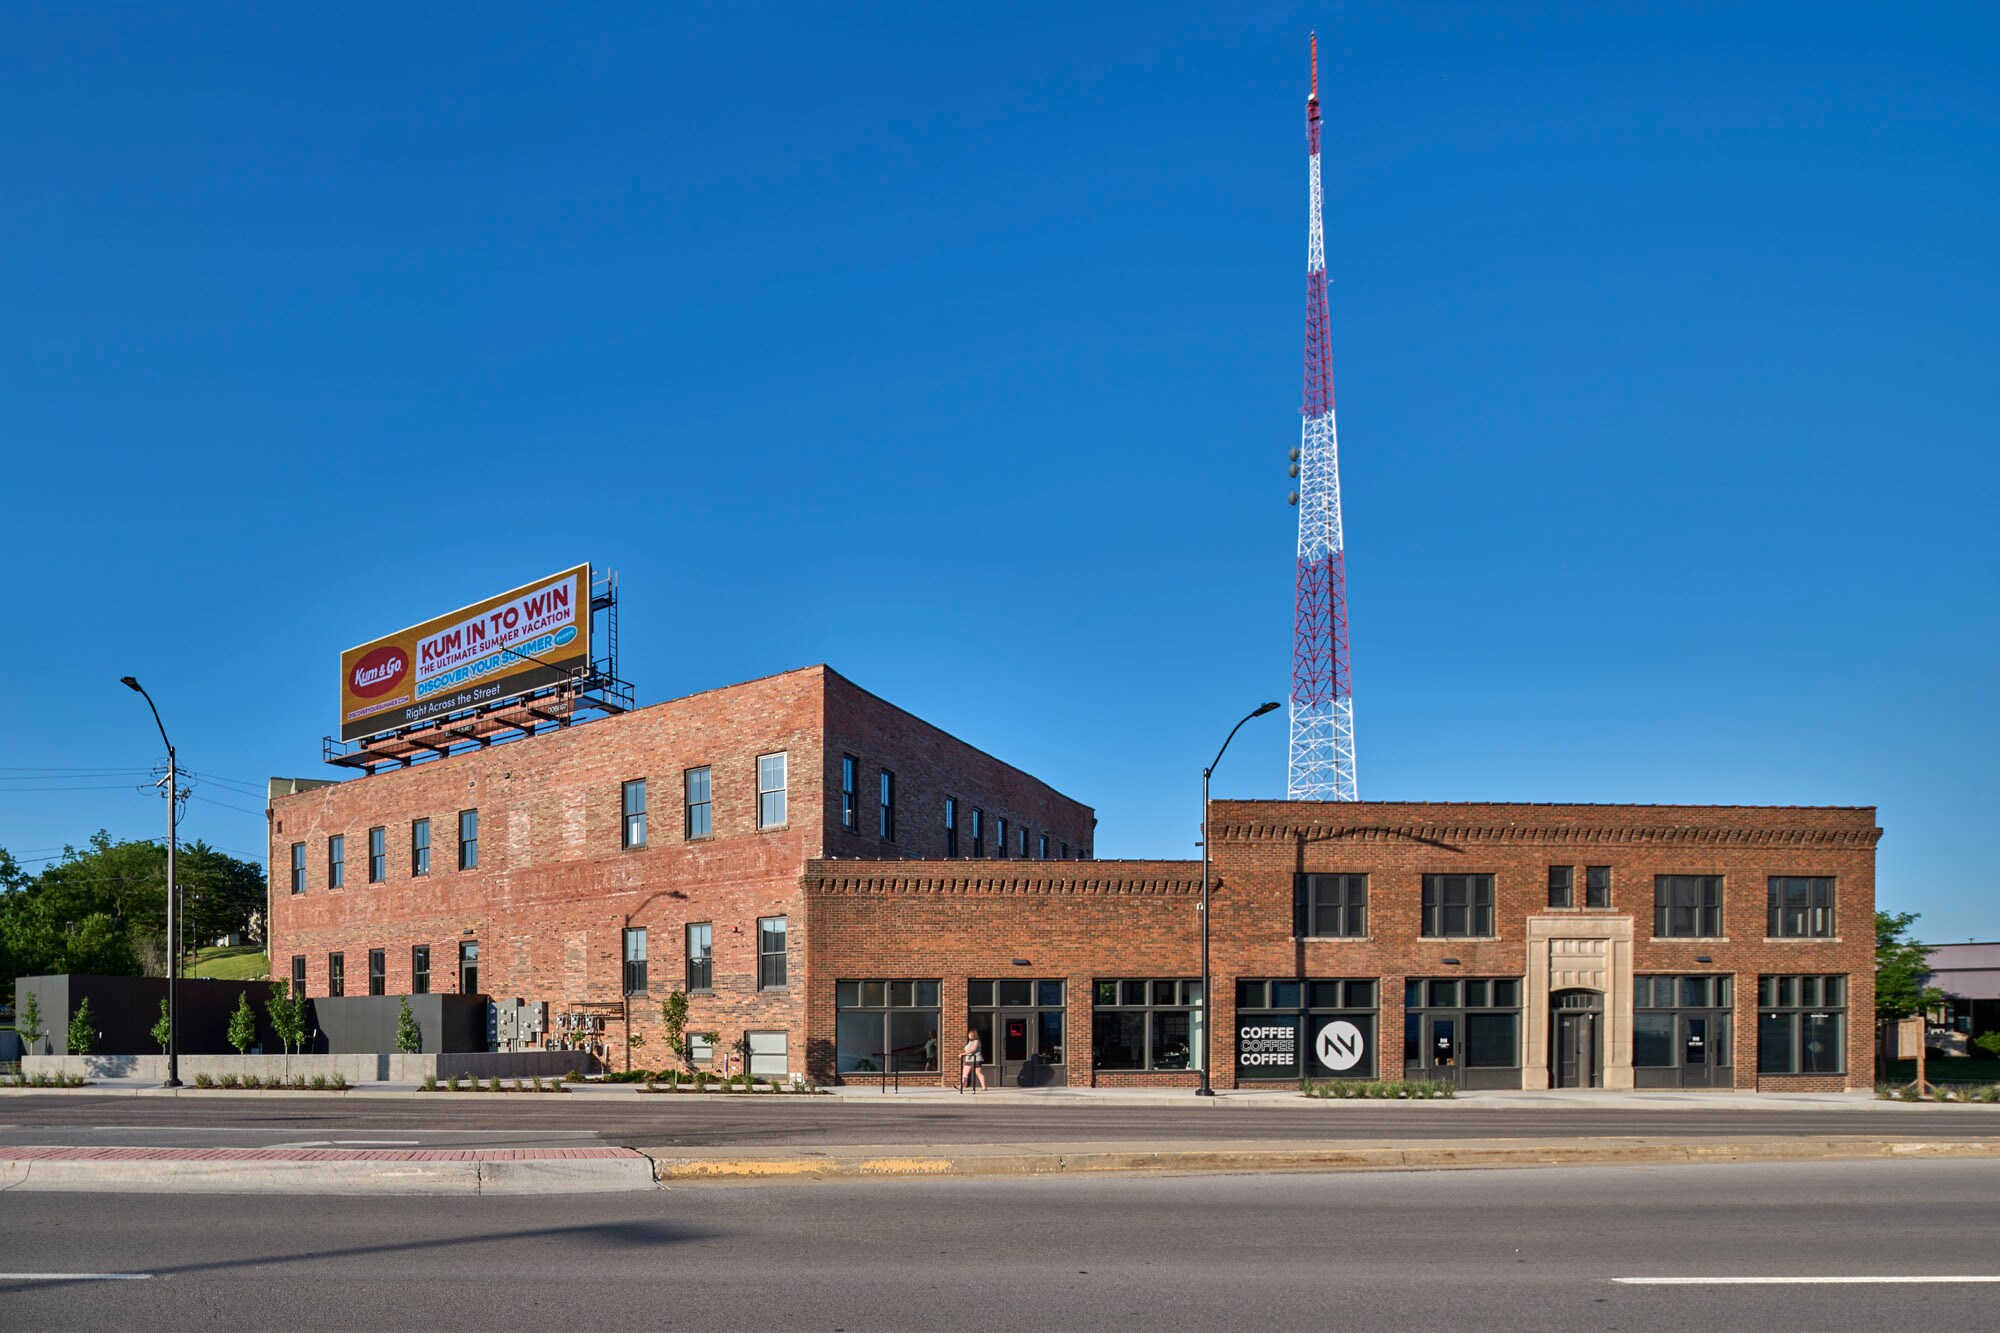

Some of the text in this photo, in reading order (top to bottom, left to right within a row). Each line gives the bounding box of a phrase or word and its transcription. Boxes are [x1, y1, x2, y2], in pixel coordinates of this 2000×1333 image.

[422, 584, 569, 664] KUM IN TO WIN
[420, 608, 570, 676] THE ULTIMATE SUMMER VACATION
[355, 667, 378, 686] Kum
[386, 657, 402, 678] Go
[417, 634, 554, 696] DISCOVER YOUR SUMMER
[406, 683, 500, 720] Right Across the Street
[1241, 1027, 1294, 1039] COFFEE
[1241, 1040, 1294, 1052] COFFEE
[1241, 1053, 1294, 1066] COFFEE
